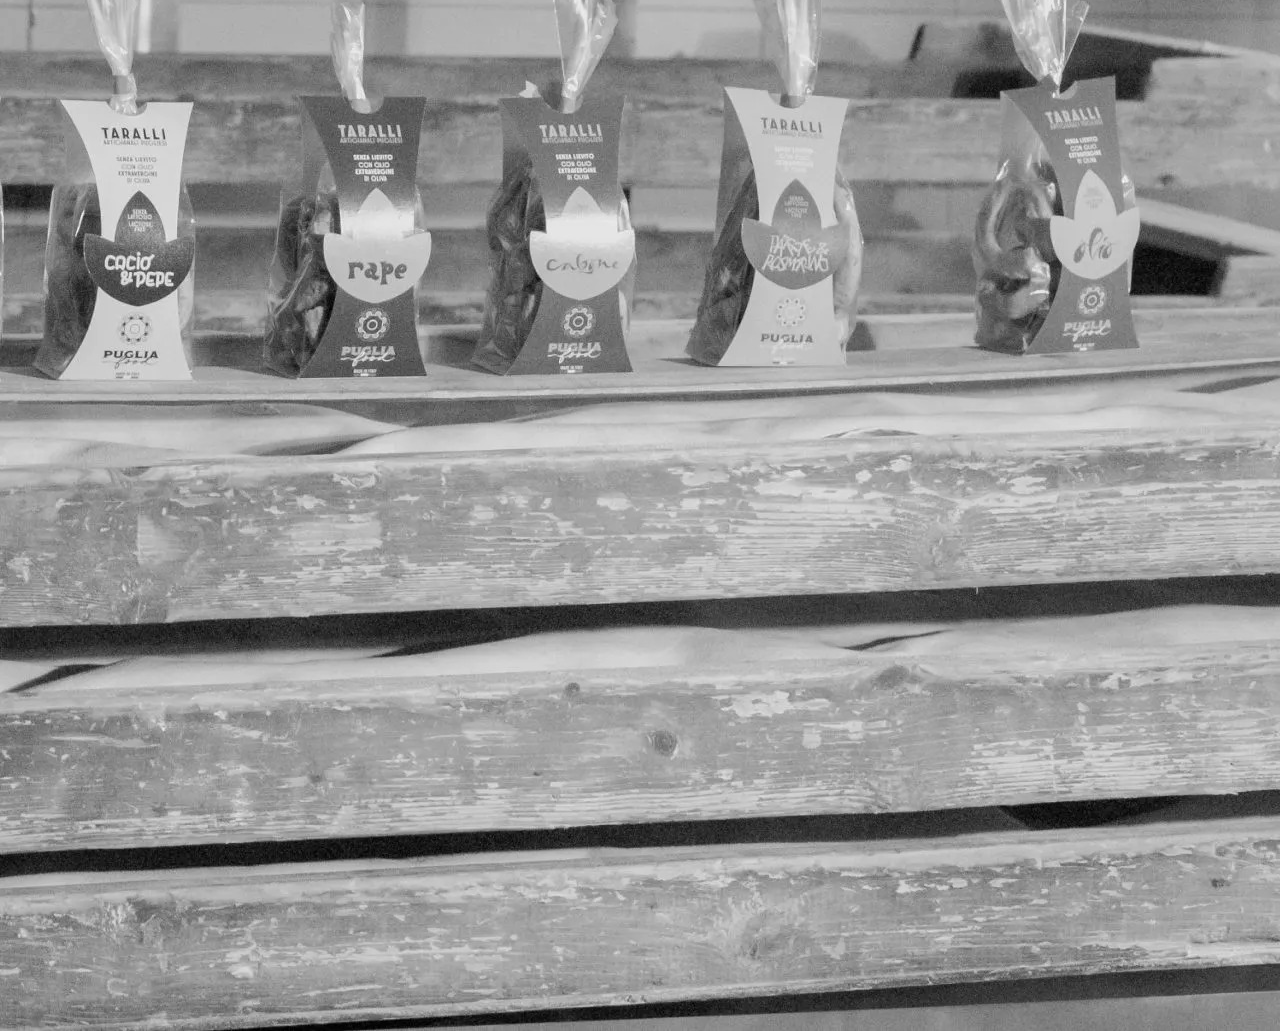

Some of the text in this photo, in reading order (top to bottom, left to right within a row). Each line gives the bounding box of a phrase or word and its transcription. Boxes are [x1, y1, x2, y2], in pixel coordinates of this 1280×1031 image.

[1044, 106, 1101, 123] TARALLI
[338, 124, 402, 138] TARALLI
[539, 123, 602, 138] TARALLI
[761, 117, 822, 133] TARALLI
[101, 127, 166, 140] TARALLI
[1073, 227, 1114, 263] olio
[347, 261, 408, 285] rape
[1064, 319, 1111, 331] PUGLIA
[760, 333, 813, 343] PUGLIA
[341, 346, 395, 356] PUGLIA
[548, 342, 601, 352] PUGLIA
[103, 350, 158, 359] PUGLIA
